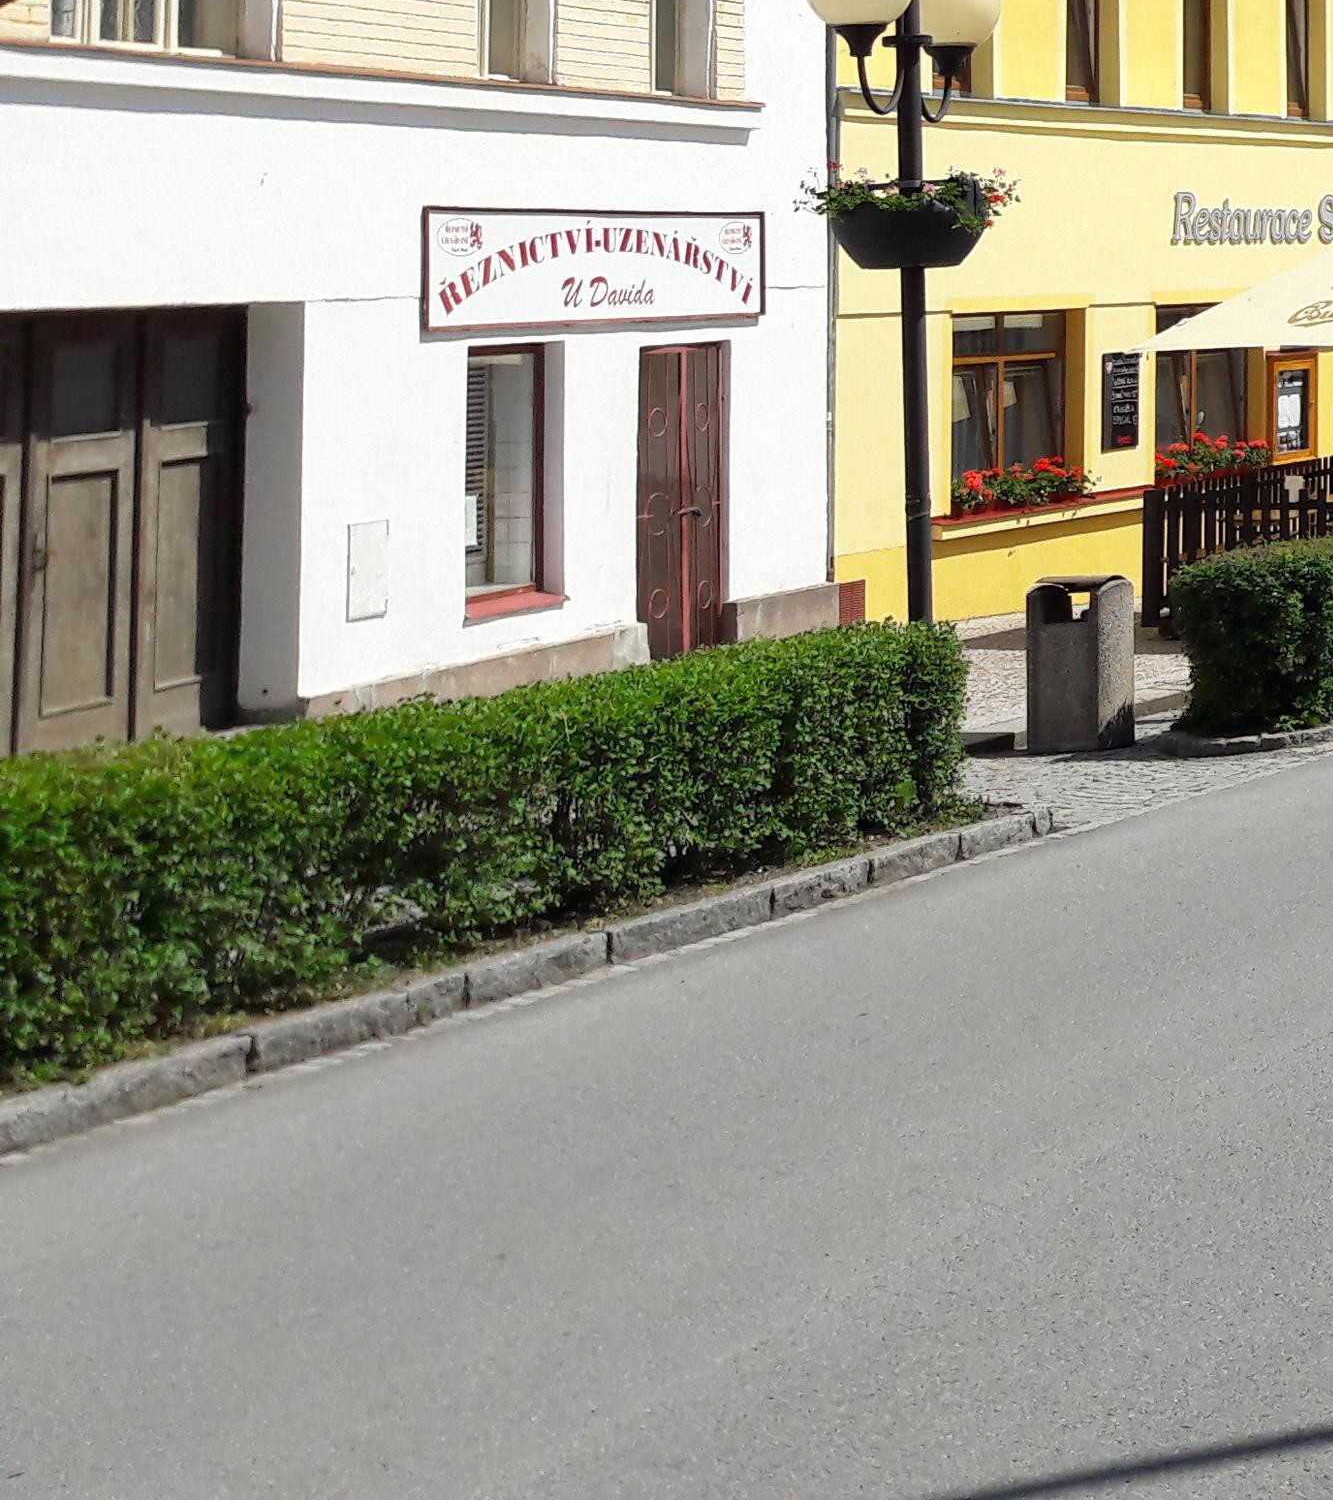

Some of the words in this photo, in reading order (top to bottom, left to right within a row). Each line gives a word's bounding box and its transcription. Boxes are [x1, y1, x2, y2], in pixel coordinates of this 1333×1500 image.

[1173, 192, 1312, 244] Restaurace
[561, 277, 583, 307] U
[590, 276, 655, 307] Davida
